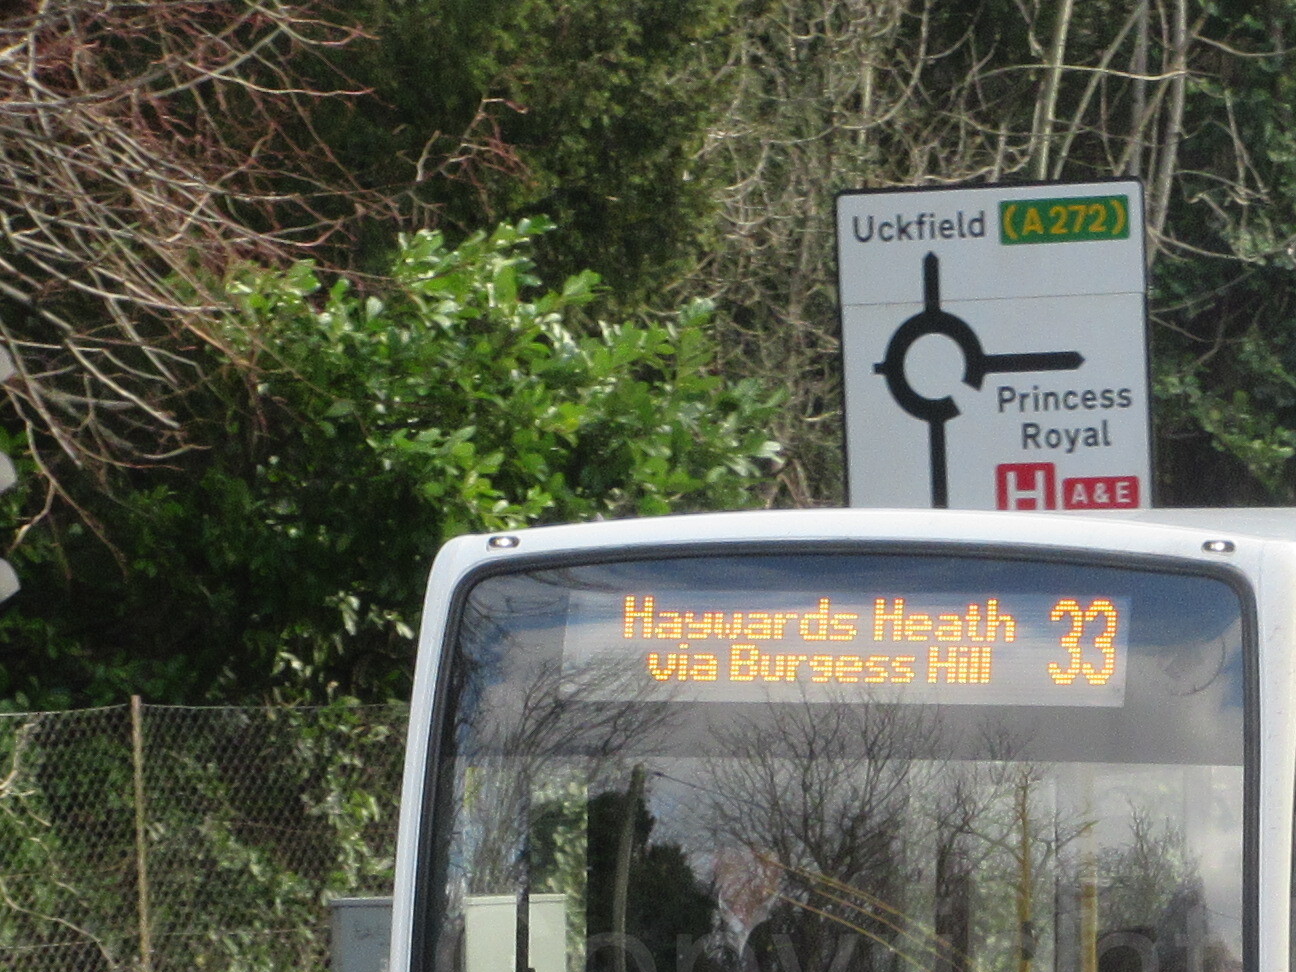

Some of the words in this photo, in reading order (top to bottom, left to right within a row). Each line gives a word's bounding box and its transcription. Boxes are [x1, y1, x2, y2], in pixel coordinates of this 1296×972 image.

[852, 211, 985, 243] Uckfield
[997, 386, 1133, 413] Princess
[1021, 419, 1111, 453] Royal
[1071, 481, 1132, 505] A&E
[622, 595, 858, 642] Haywards
[872, 597, 1016, 643] Heath
[1046, 598, 1119, 686] 33
[647, 643, 718, 682] via
[729, 643, 917, 684] Burgess
[927, 645, 992, 685] Hill
